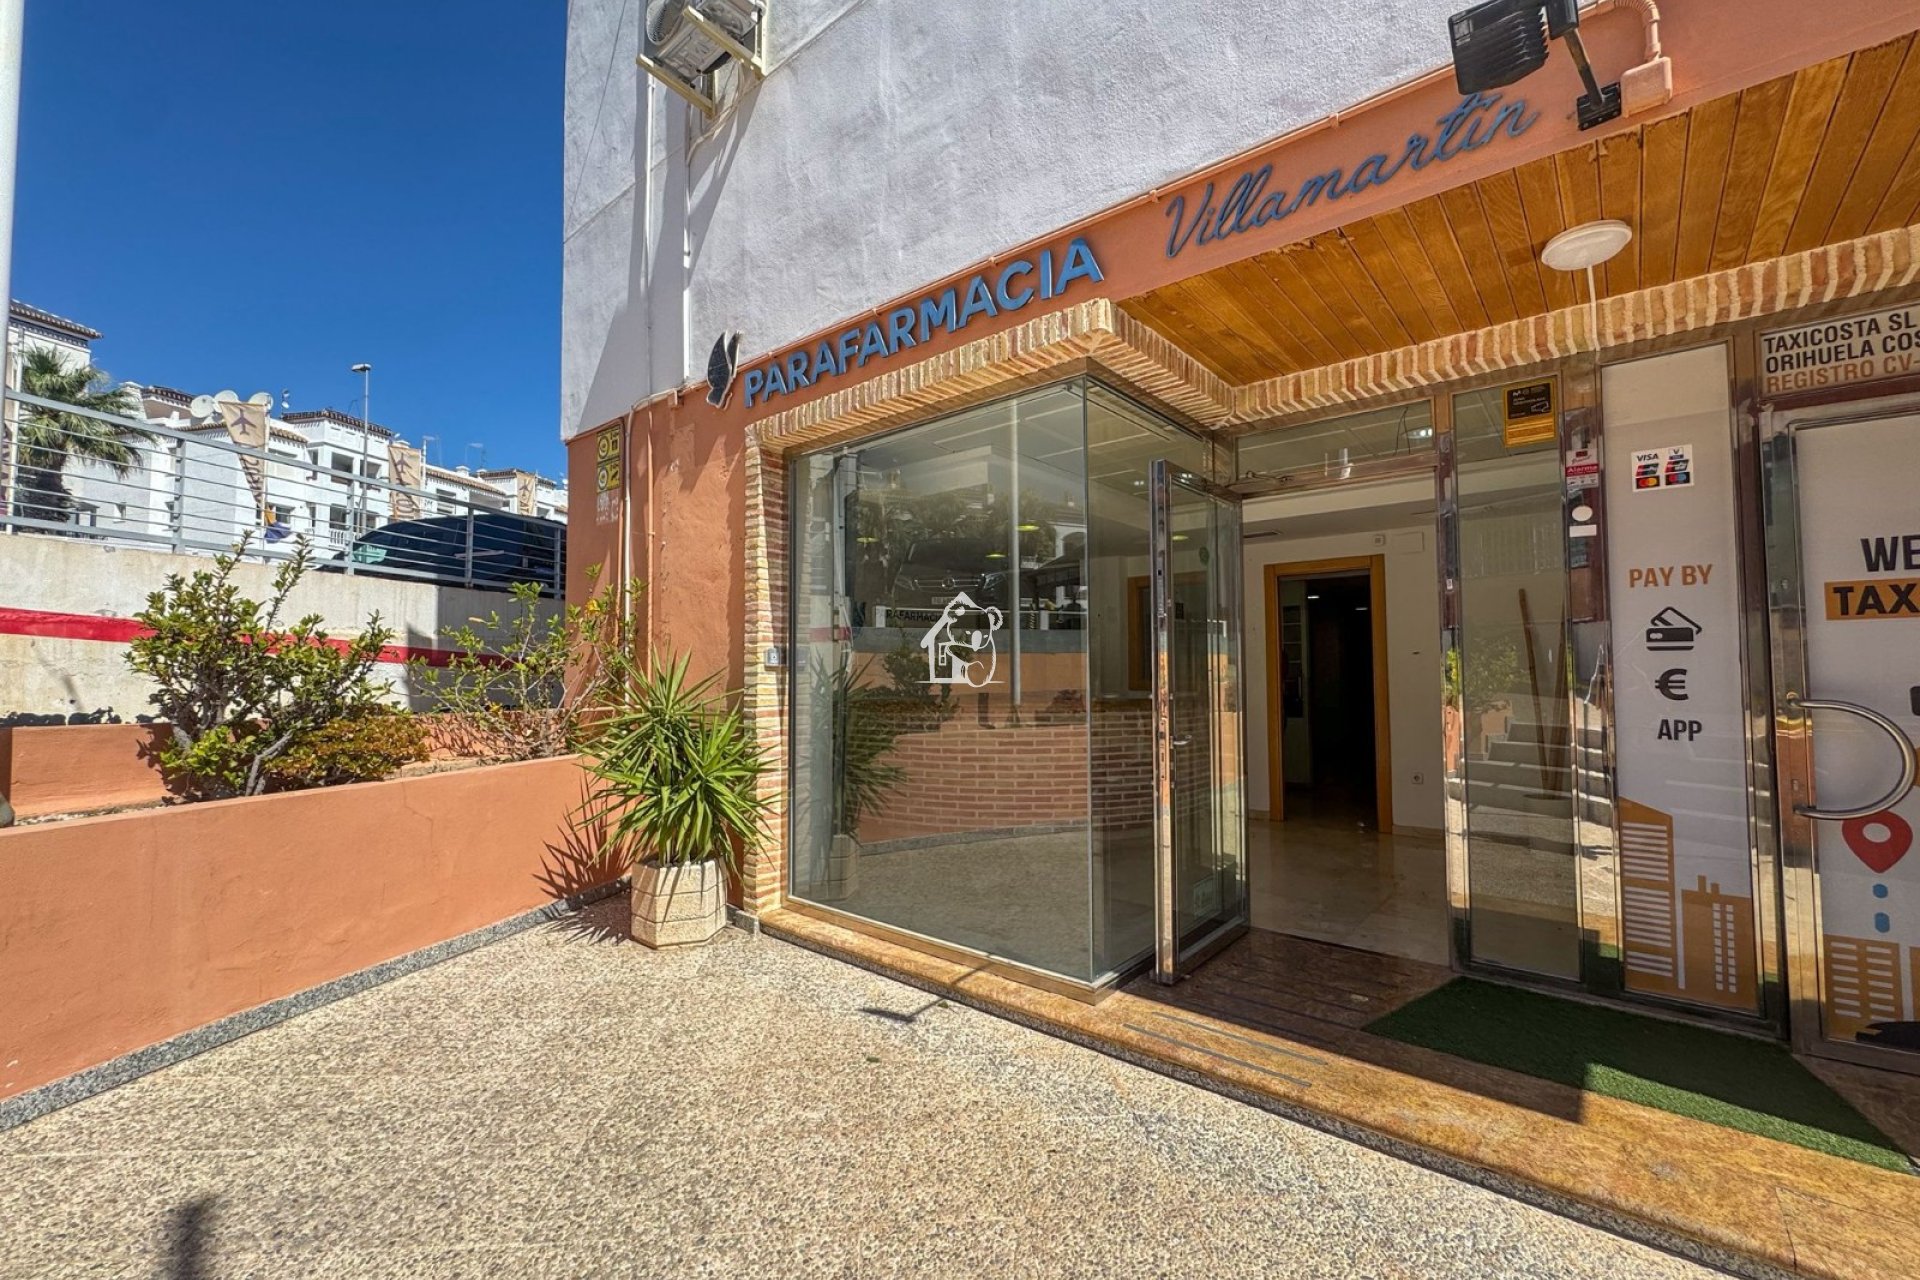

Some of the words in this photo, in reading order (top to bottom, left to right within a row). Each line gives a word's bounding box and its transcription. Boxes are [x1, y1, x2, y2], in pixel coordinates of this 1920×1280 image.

[743, 237, 1105, 409] PARAFARMACIA
[1763, 317, 1881, 354] TAXICOSTA
[1888, 310, 1917, 332] SL
[1765, 339, 1875, 374] ORIHUELA
[1766, 359, 1875, 394] REGISTRO
[1636, 453, 1660, 462] VISA
[1629, 566, 1674, 588] PAY
[1681, 563, 1713, 586] BY
[1655, 668, 1689, 701] €
[1657, 719, 1703, 741] APP
